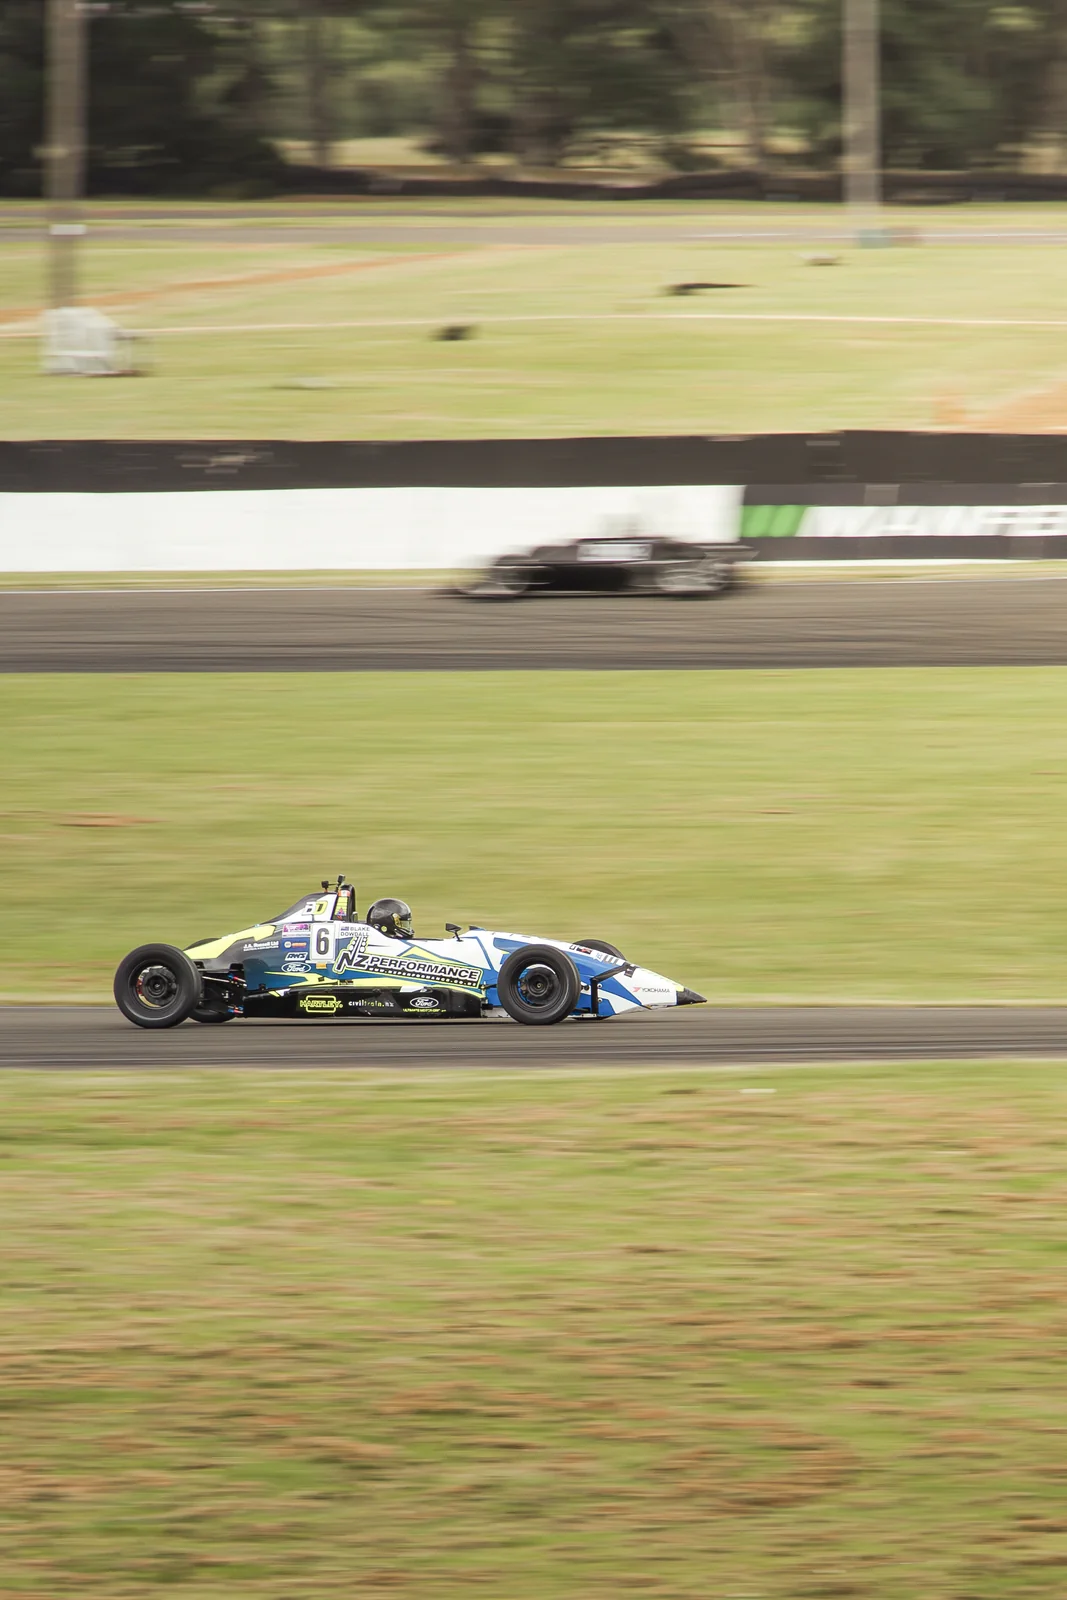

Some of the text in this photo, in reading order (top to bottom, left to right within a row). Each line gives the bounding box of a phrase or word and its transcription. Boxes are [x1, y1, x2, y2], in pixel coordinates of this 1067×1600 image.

[316, 927, 329, 955] 6
[286, 963, 306, 972] Ford
[369, 956, 479, 980] PERFORMANCE
[413, 999, 435, 1007] Ford
